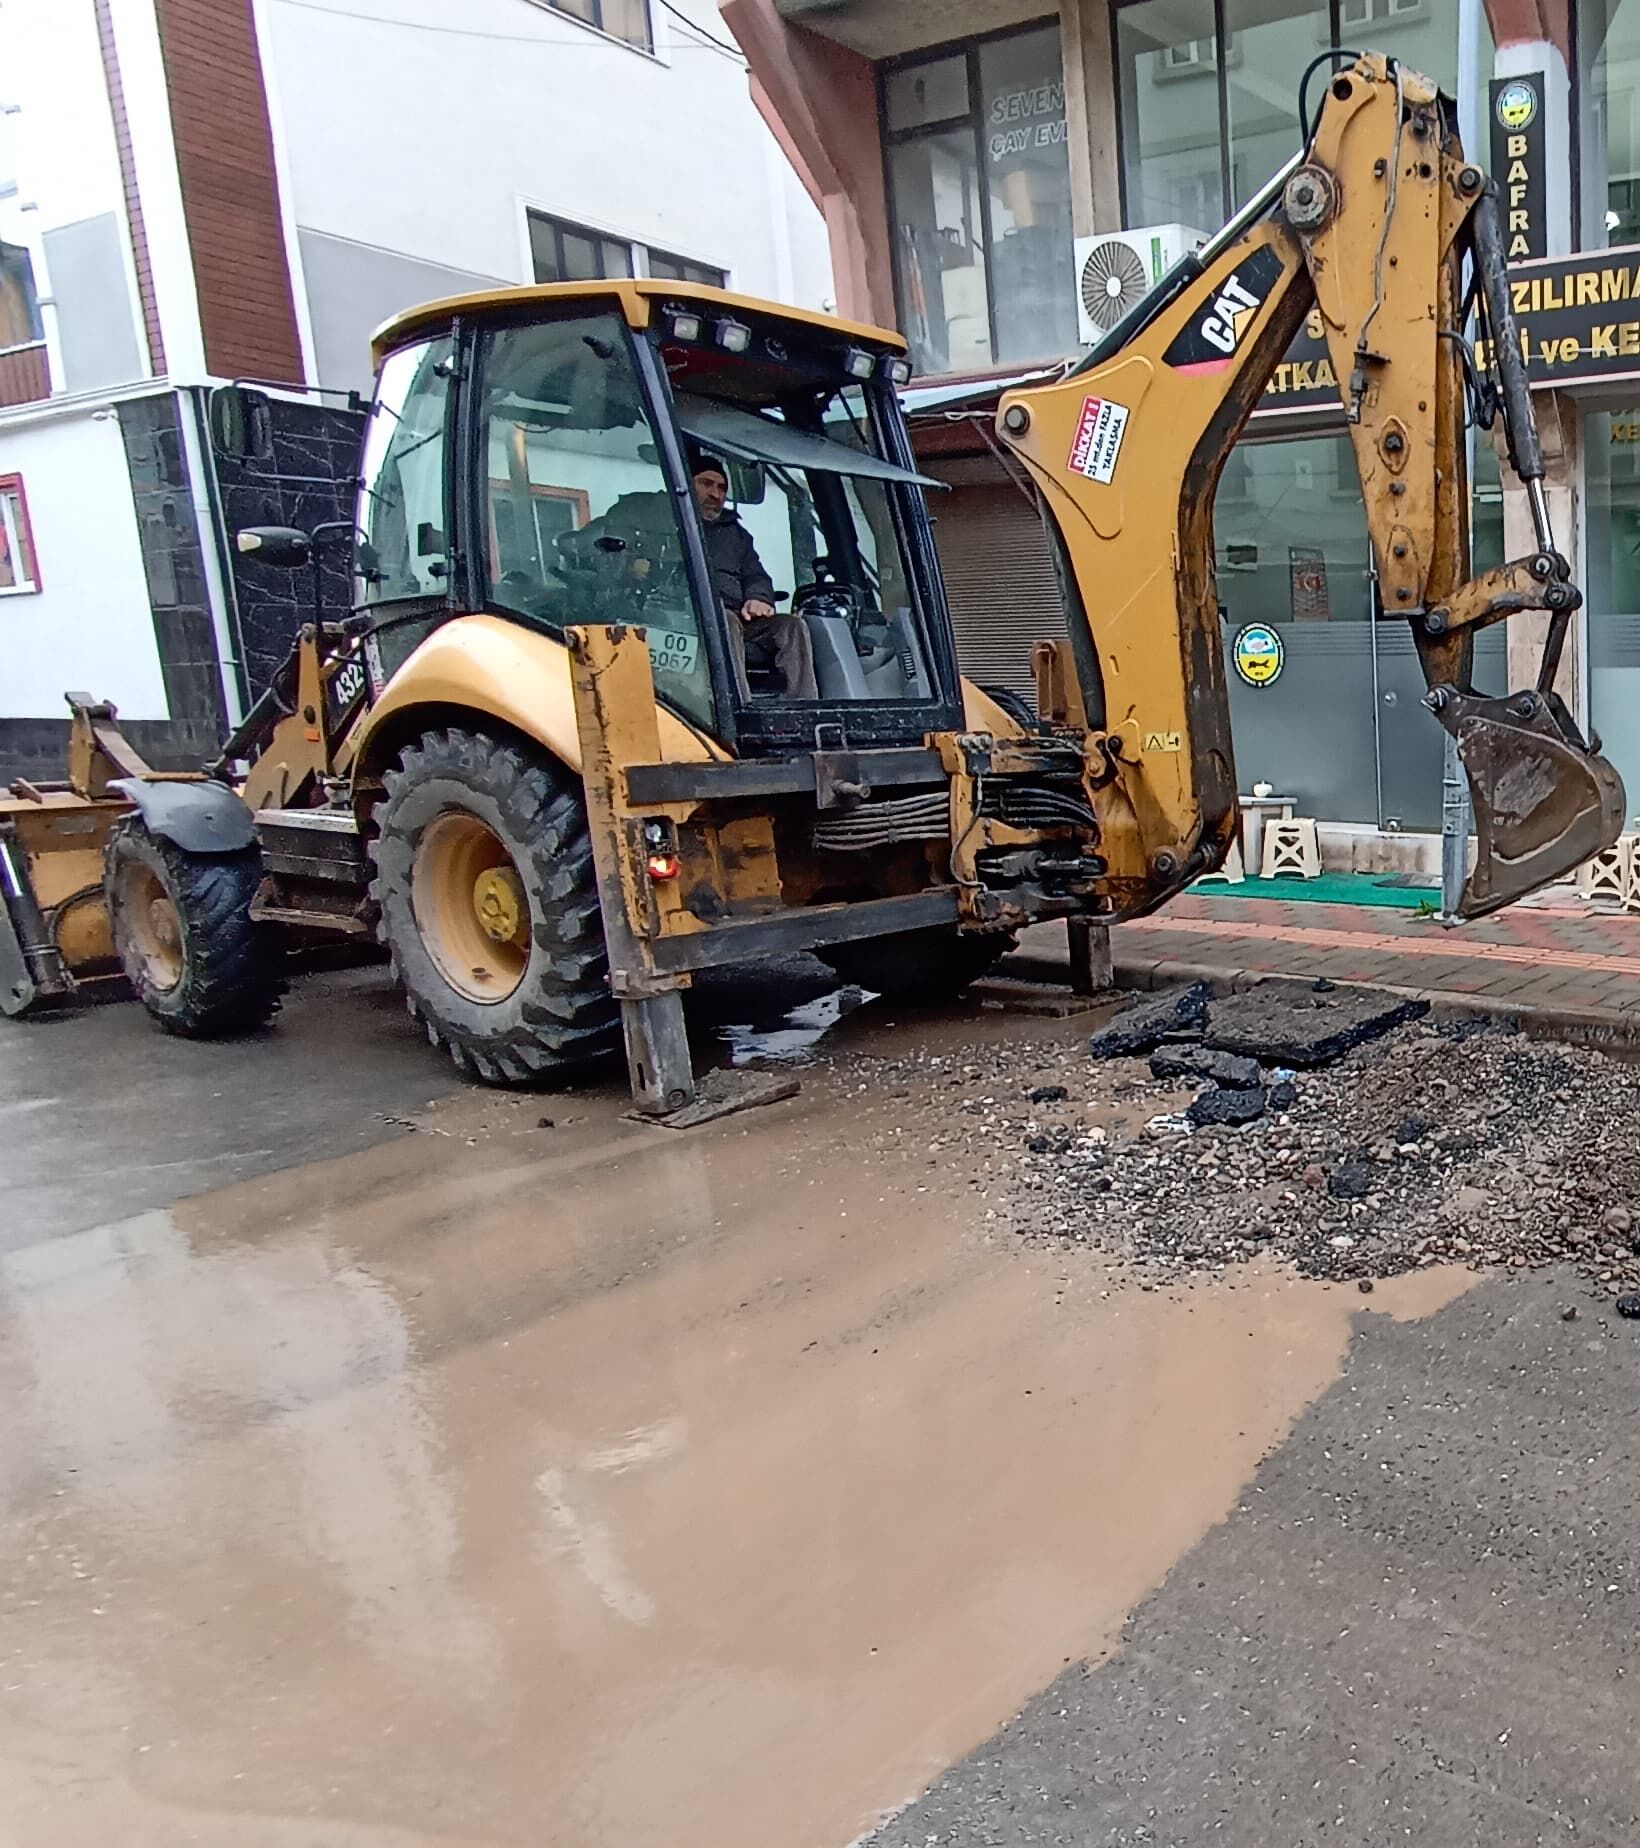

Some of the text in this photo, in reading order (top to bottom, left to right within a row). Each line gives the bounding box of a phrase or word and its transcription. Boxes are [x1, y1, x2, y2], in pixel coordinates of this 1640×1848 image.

[989, 126, 1032, 162] ÇAY
[1507, 134, 1530, 257] BAFRA
[1201, 275, 1261, 352] CAT
[1540, 336, 1580, 365] ve
